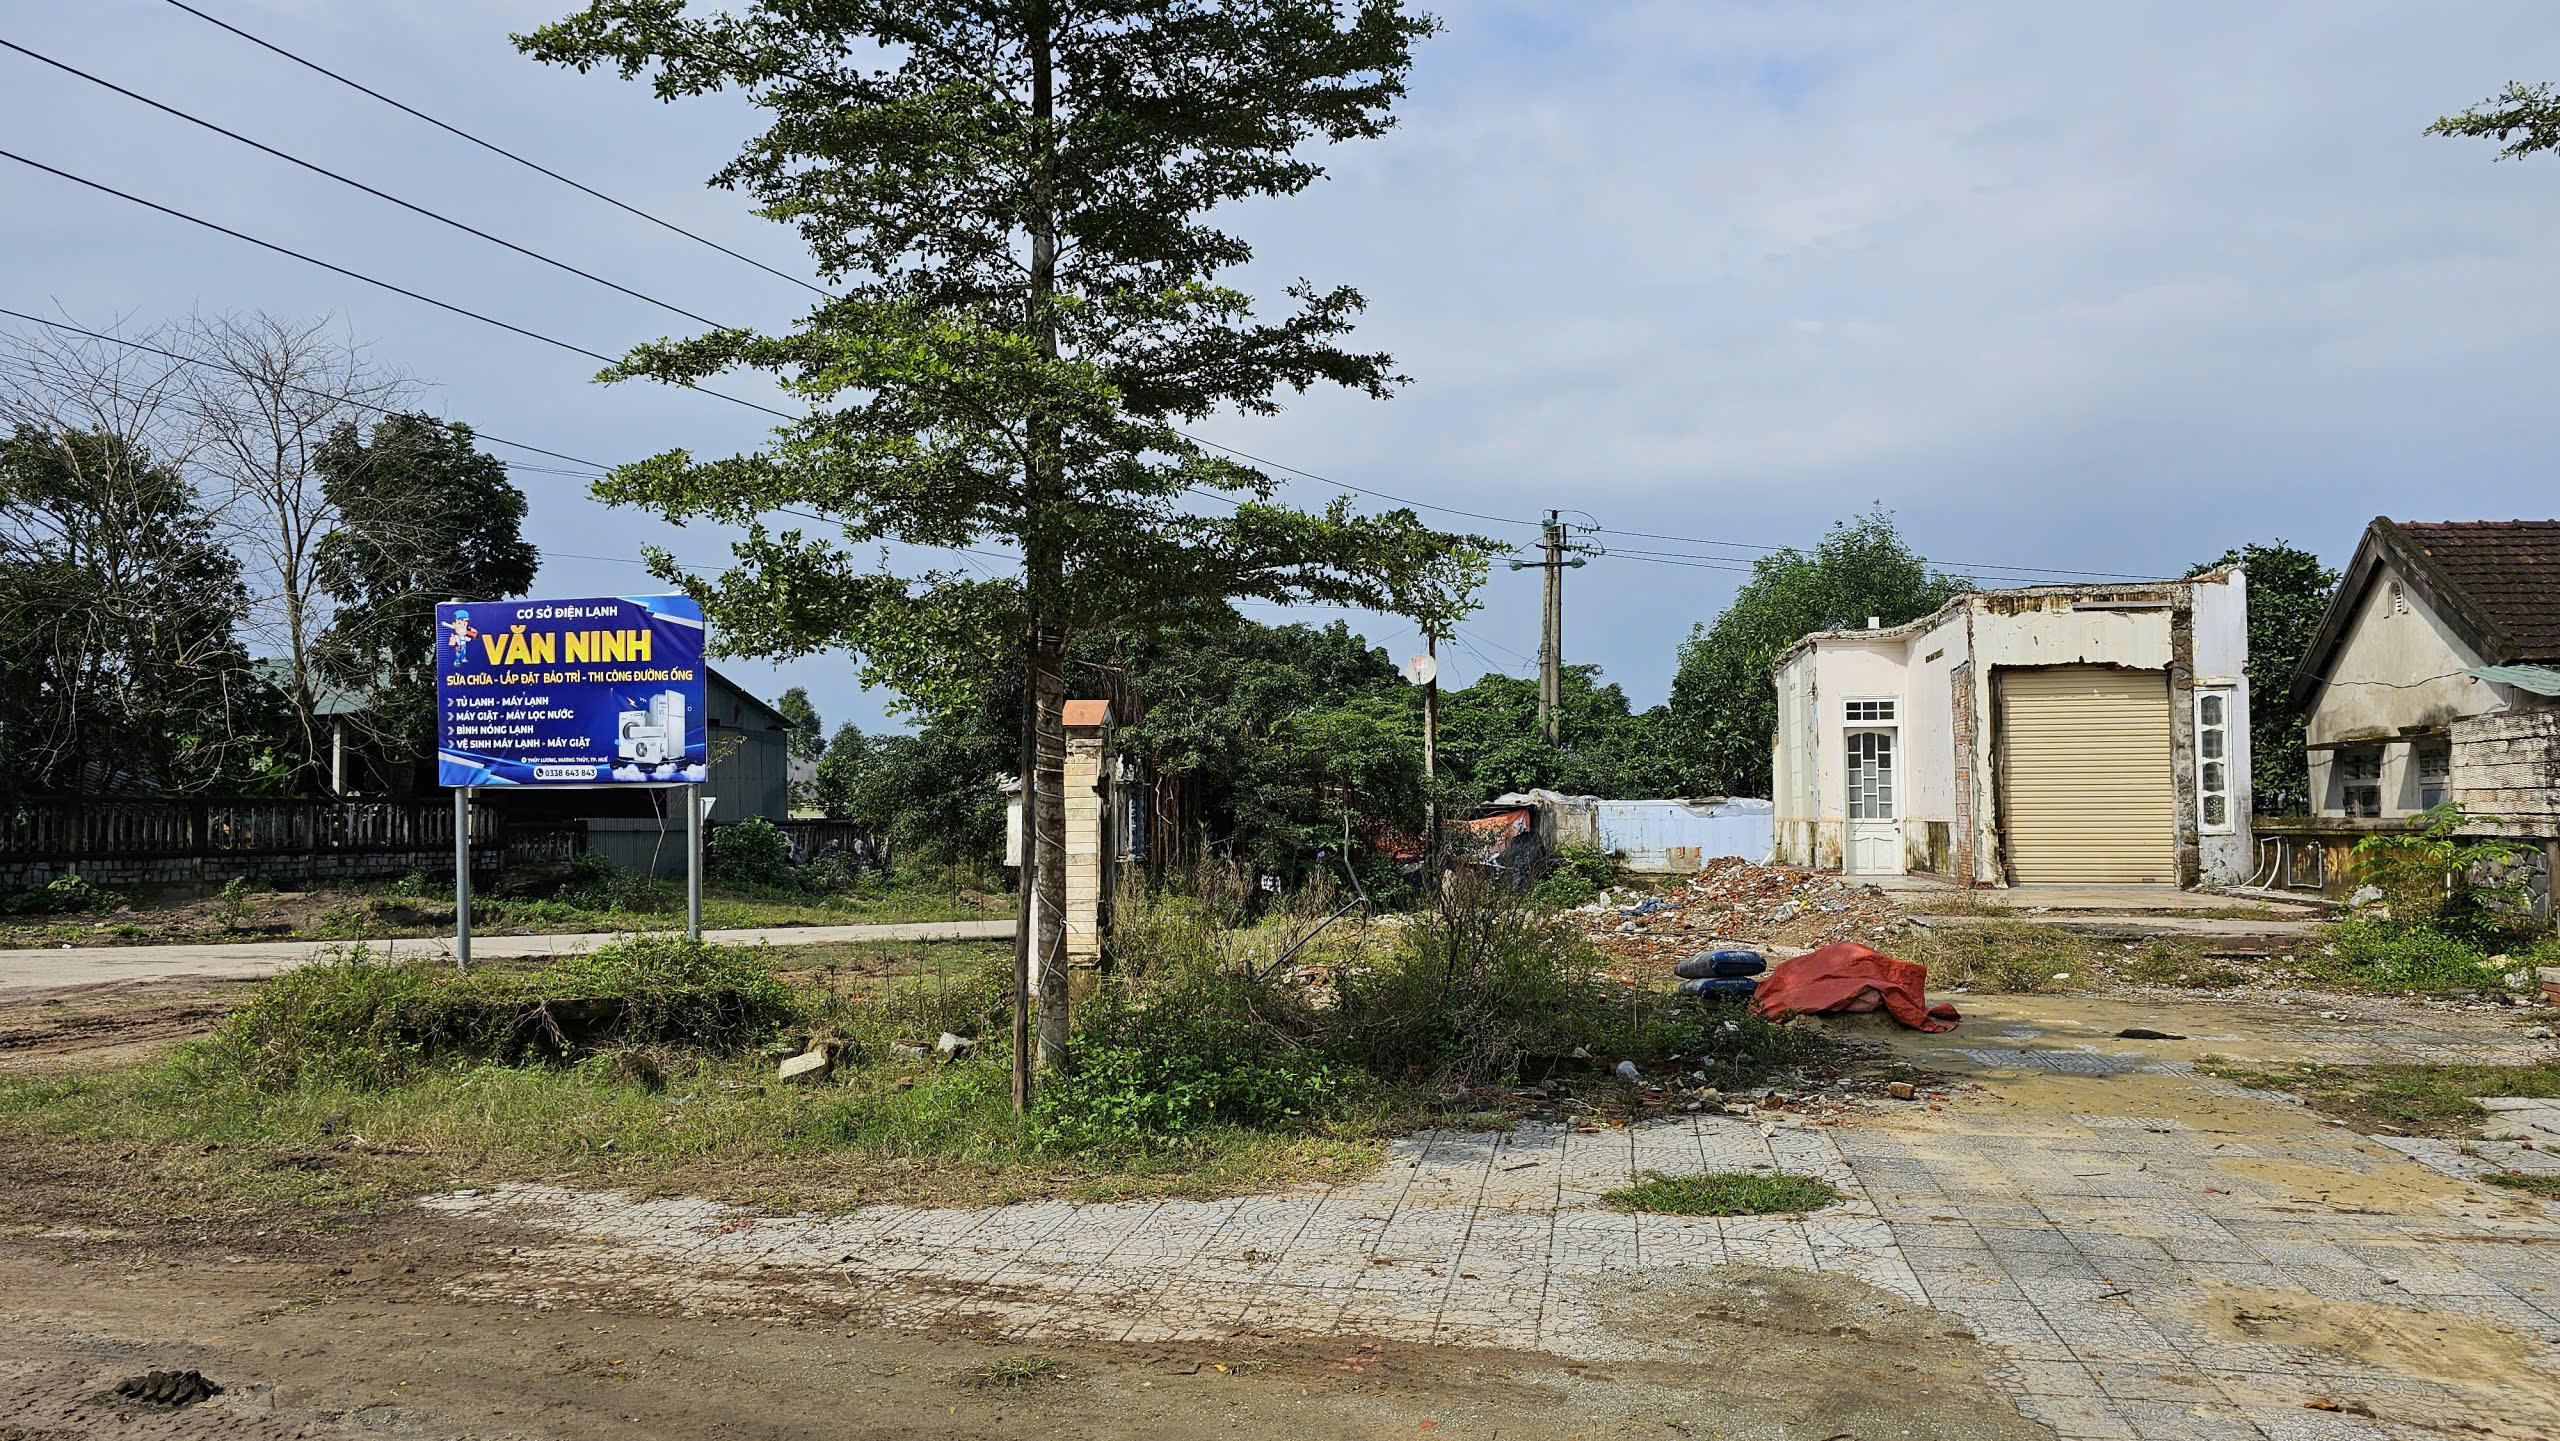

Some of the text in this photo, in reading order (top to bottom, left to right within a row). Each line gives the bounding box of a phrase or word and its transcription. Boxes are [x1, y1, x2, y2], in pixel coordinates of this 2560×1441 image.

[517, 604, 618, 620] CƠ SỞ ĐIỆN LẠNH
[482, 624, 652, 665] VĂN NINH
[446, 672, 466, 686] SỬA
[467, 672, 493, 685] CHỮA
[500, 670, 519, 684] LẮP
[521, 672, 540, 686] ĐẶT
[544, 670, 563, 684] BẢO
[565, 670, 580, 683] TRÌ
[588, 671, 604, 682] THI
[605, 669, 632, 682] CÔNG
[634, 668, 668, 681] ĐƯỜNG
[670, 666, 693, 681] ỐNG
[456, 695, 467, 707] TỦ
[469, 697, 494, 709] LẠNH
[502, 695, 523, 706] MÁY
[525, 697, 548, 708] LẠNH
[456, 710, 475, 721] MÁY
[477, 709, 498, 723] GIẶT
[506, 709, 526, 720] MÁY
[528, 710, 545, 721] LỌC
[548, 708, 574, 719] NƯỚC
[457, 724, 533, 736] BÌNH NÓNG LẠNH
[456, 737, 468, 750] VỆ
[470, 739, 491, 749] SINH
[493, 737, 513, 748] MÁY
[515, 739, 540, 750] LẠNH
[548, 737, 567, 747] MÁY
[569, 736, 590, 749] GIẶT
[545, 769, 563, 777] 0338
[565, 769, 579, 777] 643
